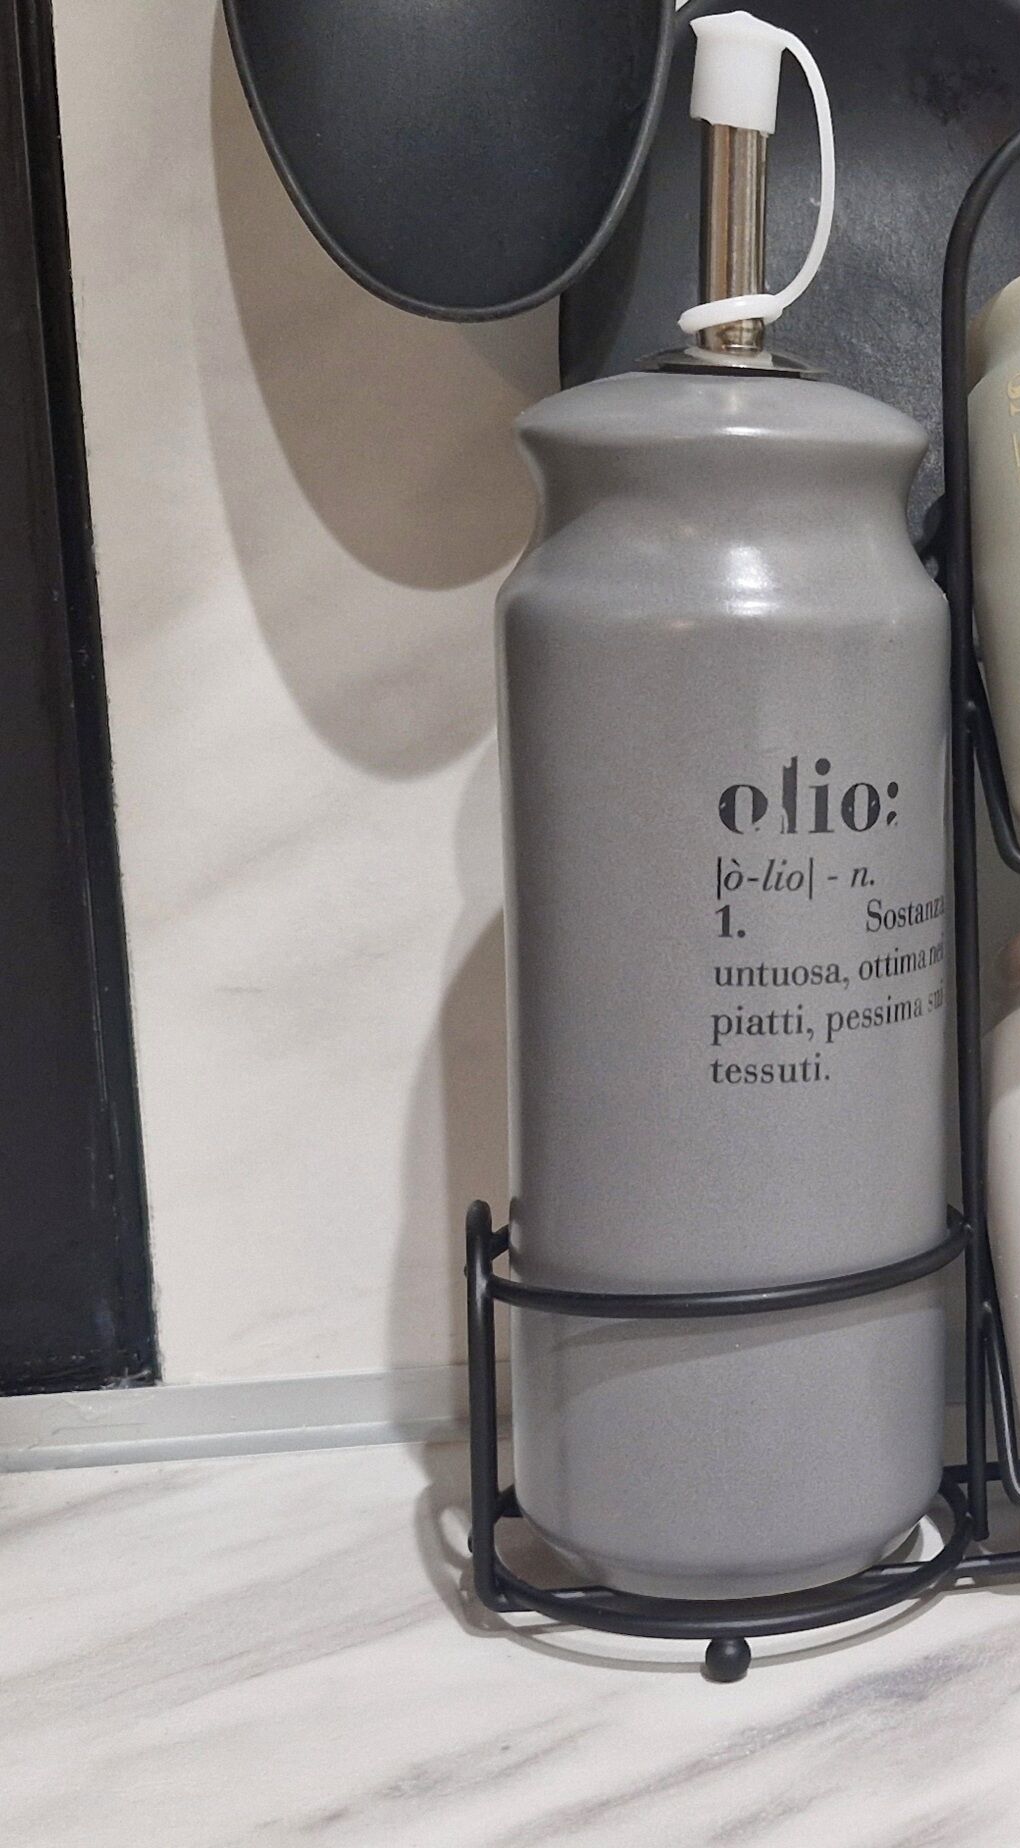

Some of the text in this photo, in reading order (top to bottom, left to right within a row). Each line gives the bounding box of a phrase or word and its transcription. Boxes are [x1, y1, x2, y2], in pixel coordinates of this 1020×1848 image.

[718, 755, 899, 835] olio:
[850, 866, 875, 888] n.
[714, 904, 746, 938] 1.
[714, 962, 849, 990] untuosa,
[859, 946, 927, 981] ottima
[711, 1004, 814, 1046] piatti,
[825, 995, 922, 1043] pessima
[711, 1052, 830, 1085] tessuti.
